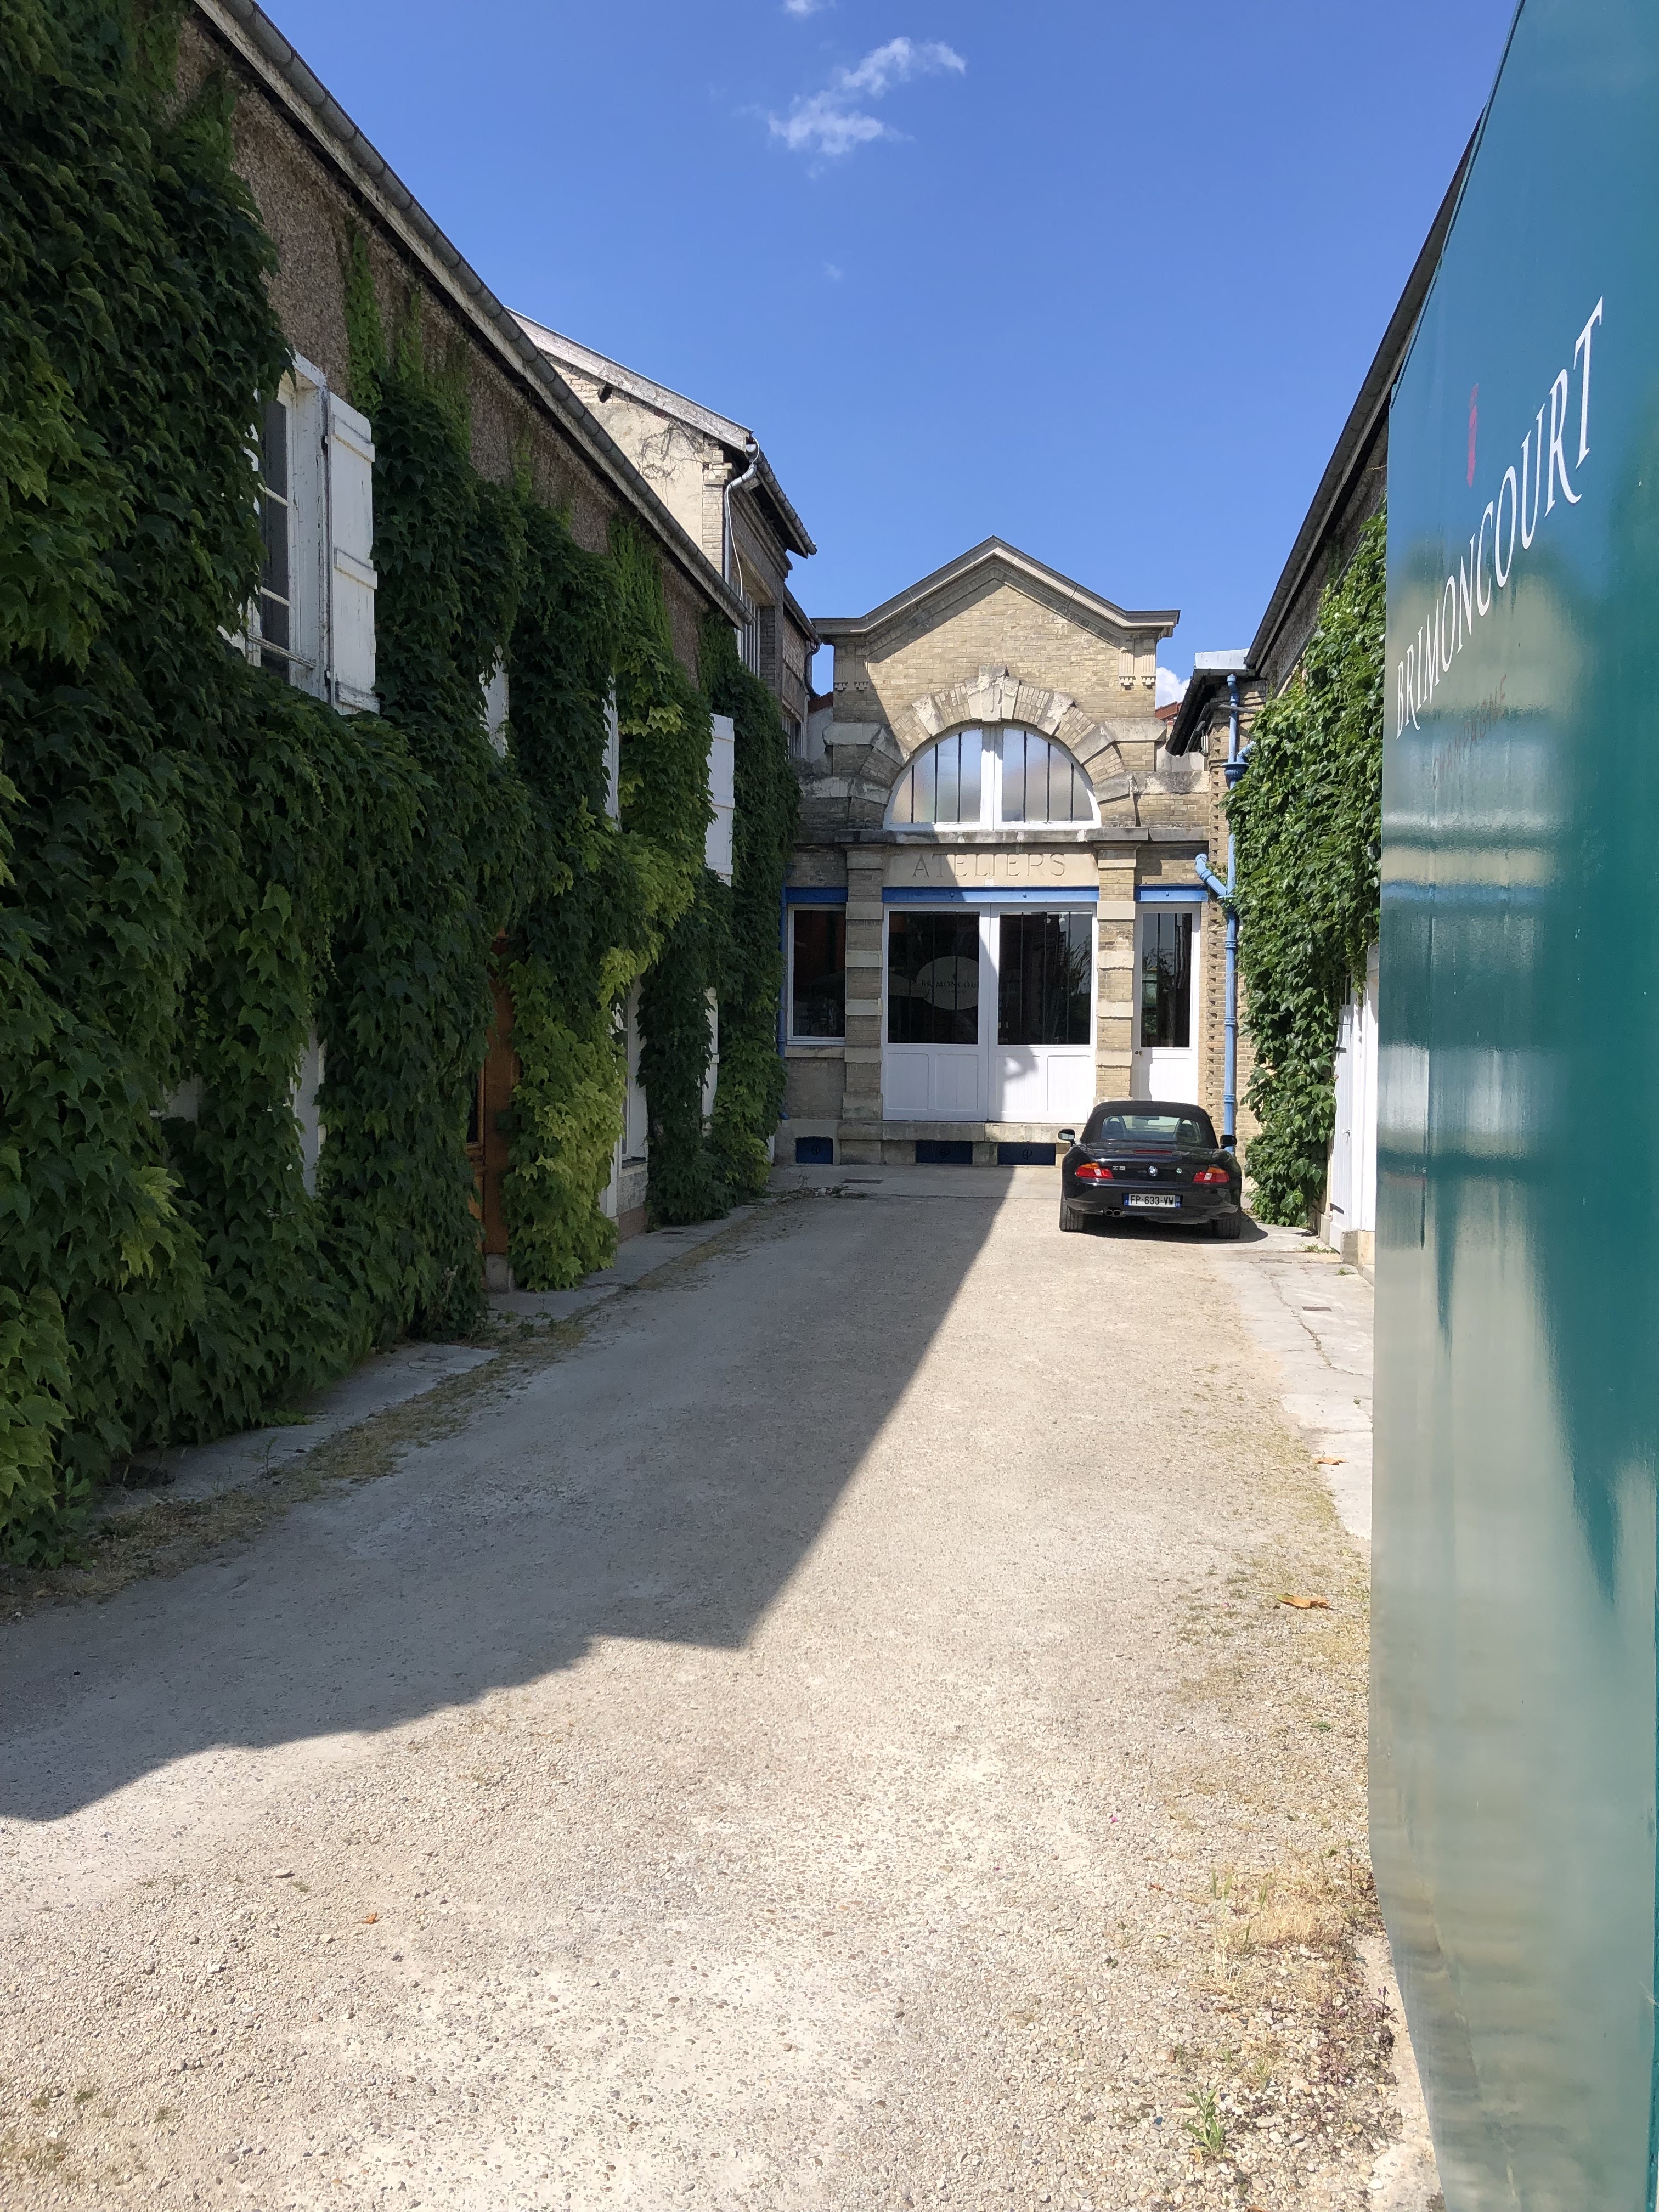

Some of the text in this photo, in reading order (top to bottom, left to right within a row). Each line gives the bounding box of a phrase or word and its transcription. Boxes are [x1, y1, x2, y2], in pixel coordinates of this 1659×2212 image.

[1396, 295, 1604, 740] BRIMONCOURT
[912, 853, 1066, 878] ATELIERS
[1130, 1195, 1174, 1206] FP-633-VW
